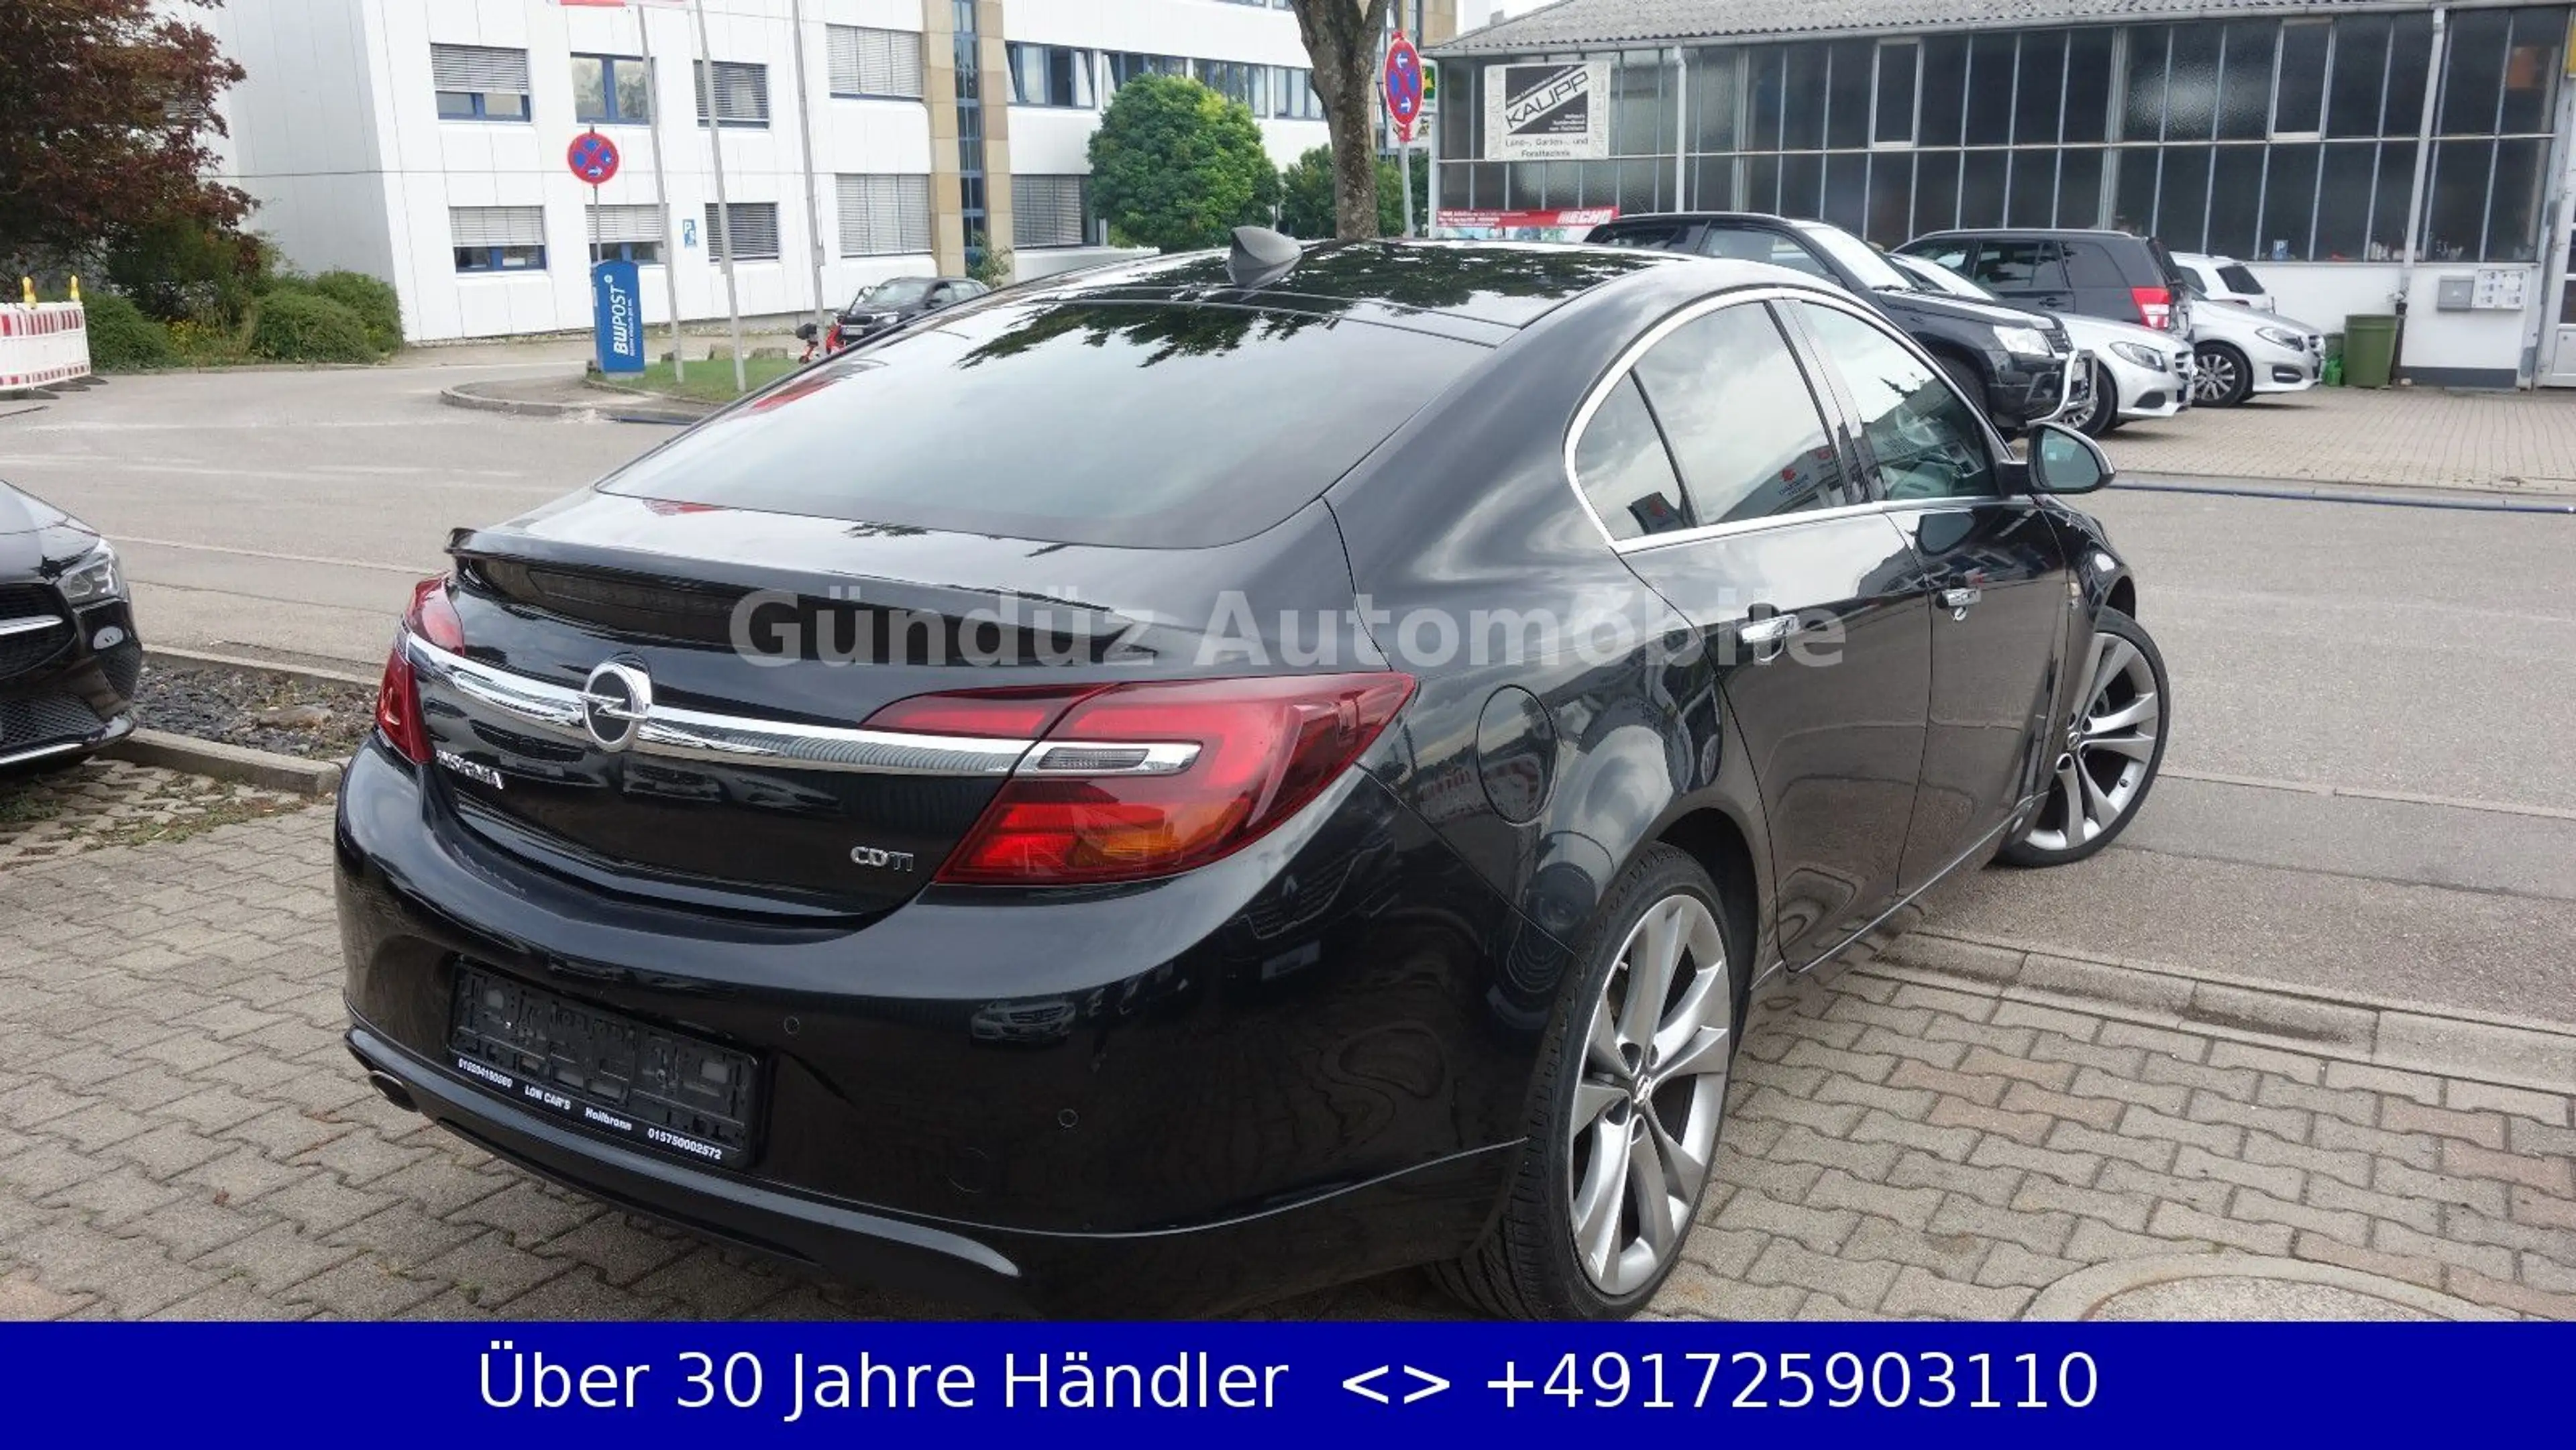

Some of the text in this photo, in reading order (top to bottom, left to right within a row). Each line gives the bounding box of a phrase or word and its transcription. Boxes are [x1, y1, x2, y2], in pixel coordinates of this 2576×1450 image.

[1505, 70, 1589, 129] KAUPP
[610, 284, 629, 355] BWPOST
[436, 749, 504, 790] INSIGNIA
